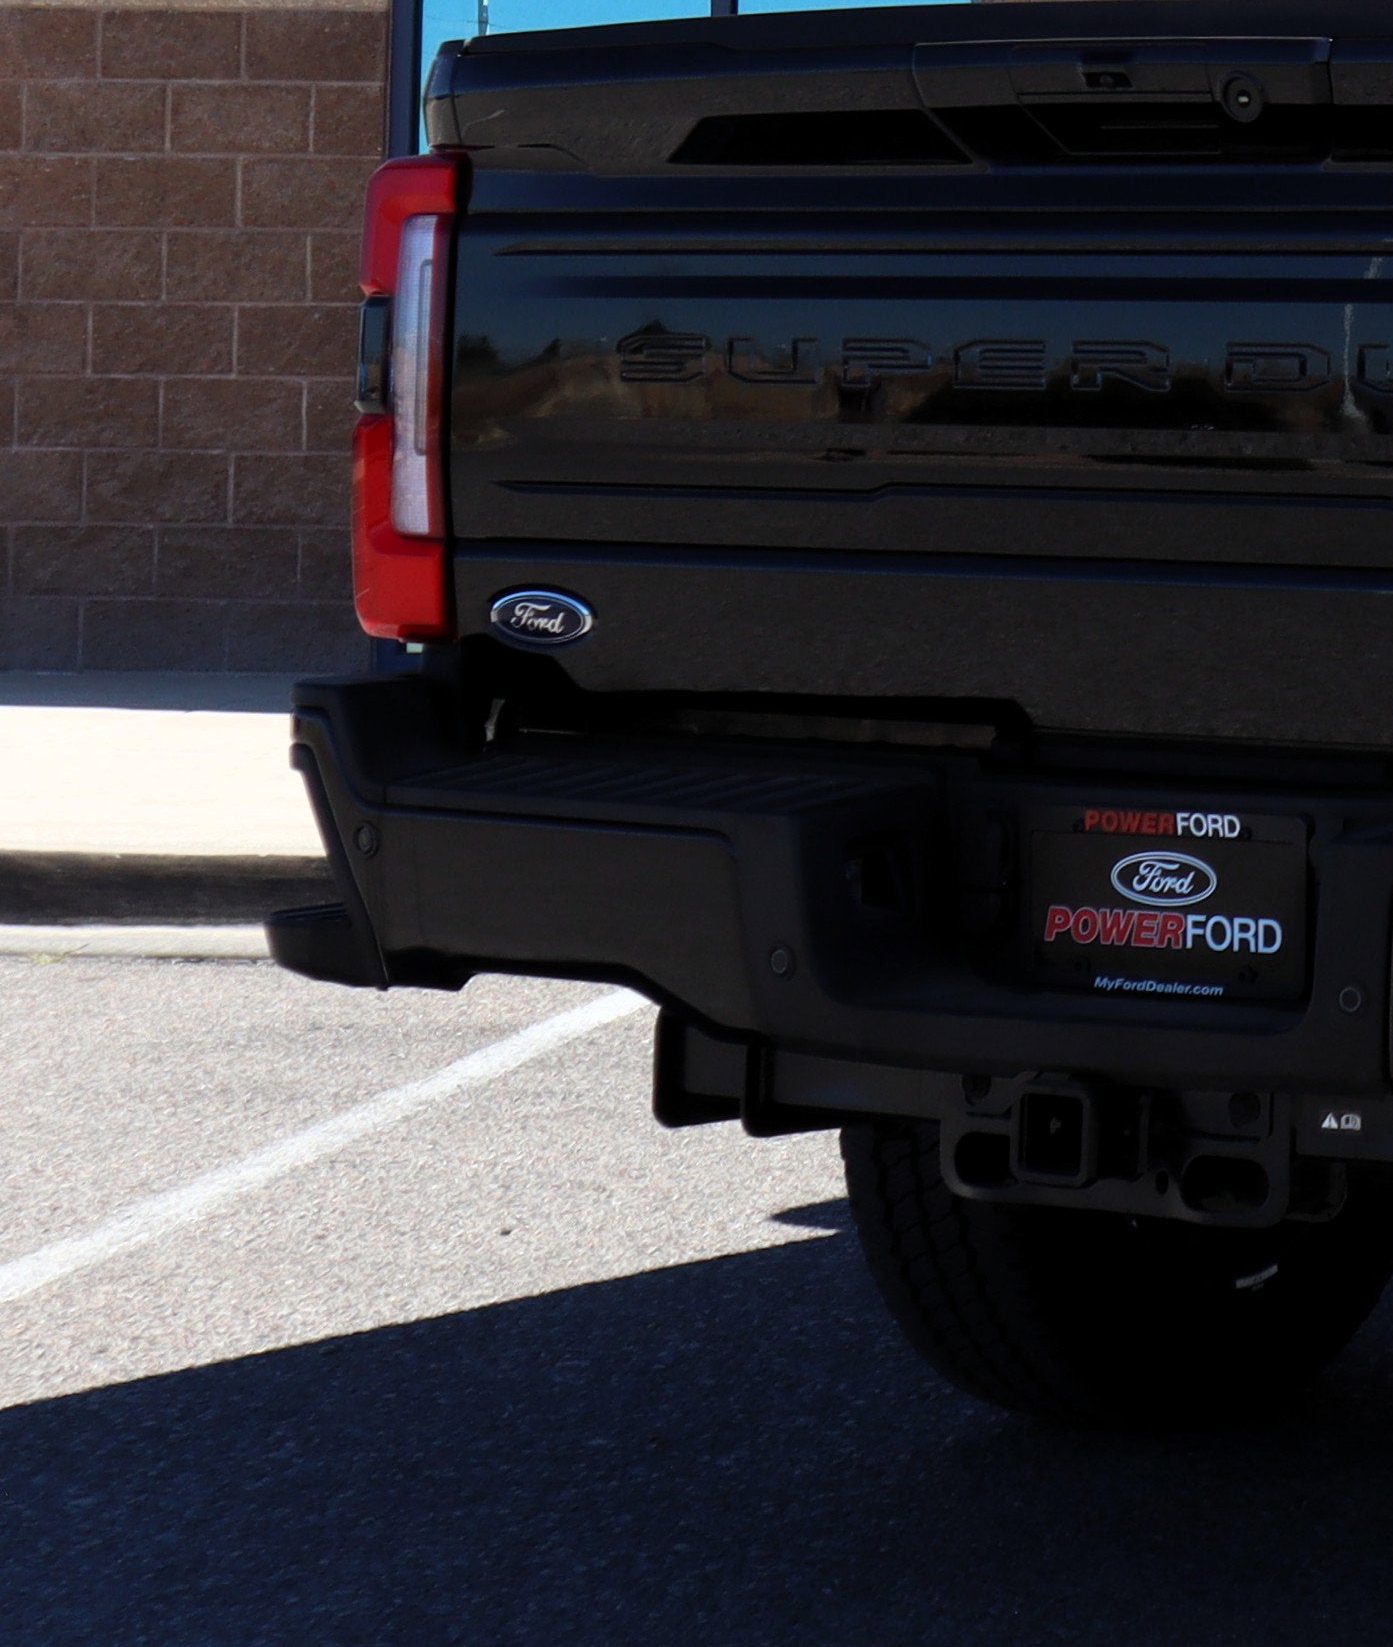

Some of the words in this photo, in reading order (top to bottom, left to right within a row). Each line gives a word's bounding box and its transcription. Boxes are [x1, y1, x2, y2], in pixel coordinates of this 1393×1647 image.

[615, 331, 1171, 393] SUPER
[510, 602, 566, 634] Ford
[1082, 809, 1242, 839] POWERFORD
[1132, 860, 1196, 895] Ford
[1043, 904, 1283, 954] POWERFORD
[1094, 975, 1225, 997] MyFordDealer.com
